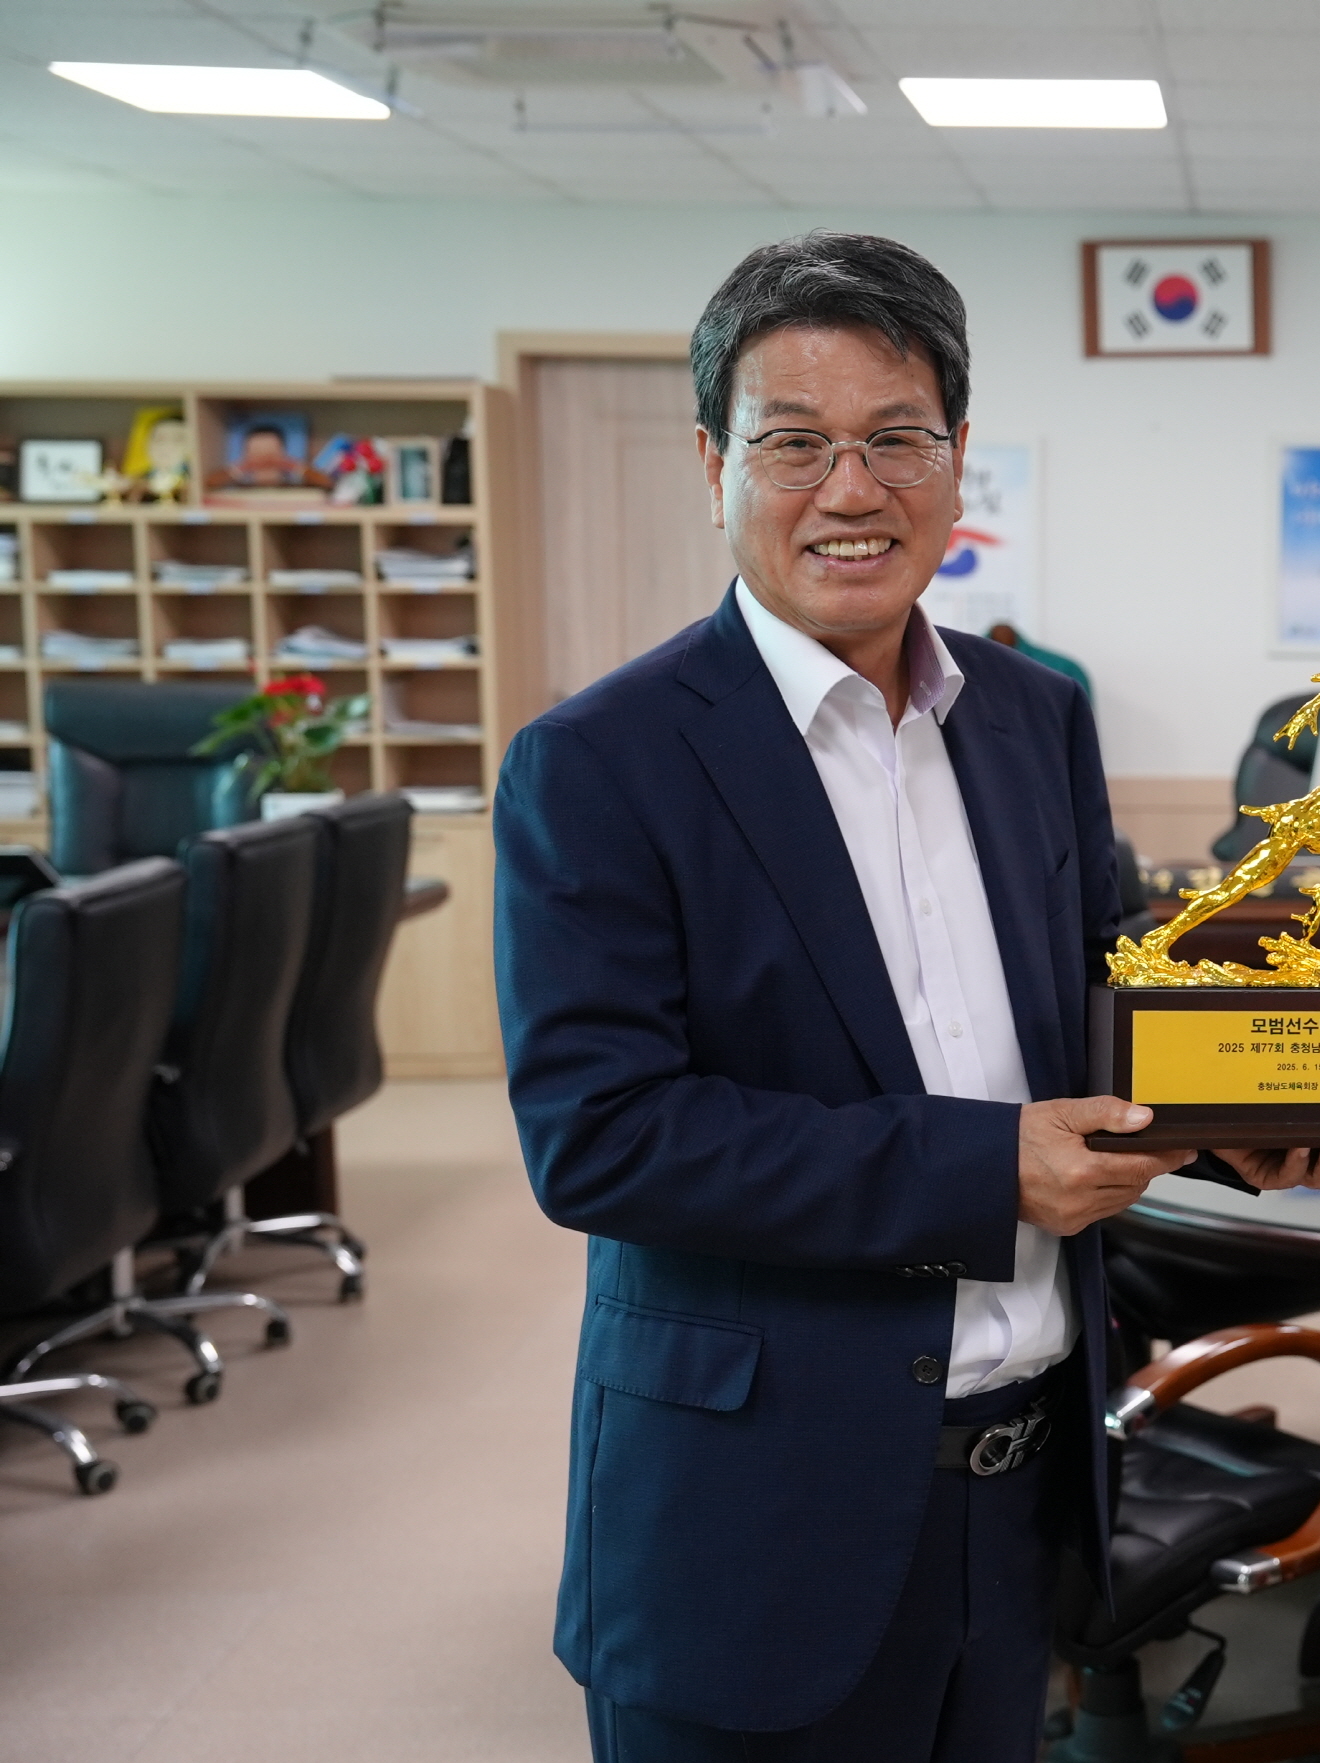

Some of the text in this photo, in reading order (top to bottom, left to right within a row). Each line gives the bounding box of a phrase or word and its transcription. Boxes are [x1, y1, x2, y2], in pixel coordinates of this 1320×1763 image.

[1218, 1042, 1245, 1053] 2025
[1250, 1042, 1285, 1054] 제77회
[1277, 1063, 1299, 1071] 2025.
[1302, 1063, 1310, 1071] 6.
[1257, 1081, 1319, 1091] 충청남도체육회장
